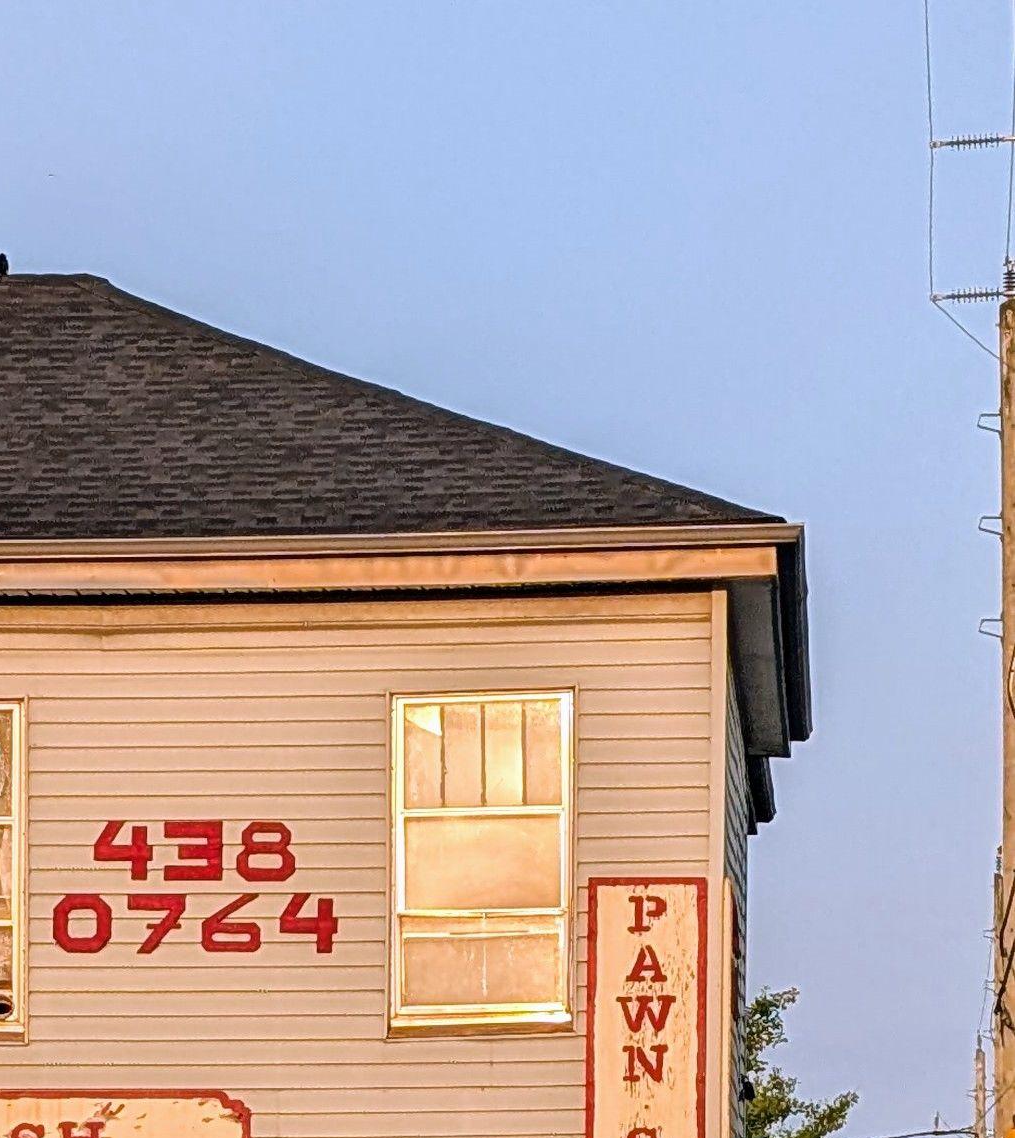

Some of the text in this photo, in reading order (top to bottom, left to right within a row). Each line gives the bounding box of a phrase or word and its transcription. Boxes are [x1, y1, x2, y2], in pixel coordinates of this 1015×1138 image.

[93, 820, 295, 882] 438
[53, 893, 338, 954] 0764
[616, 895, 676, 1083] PAWN
